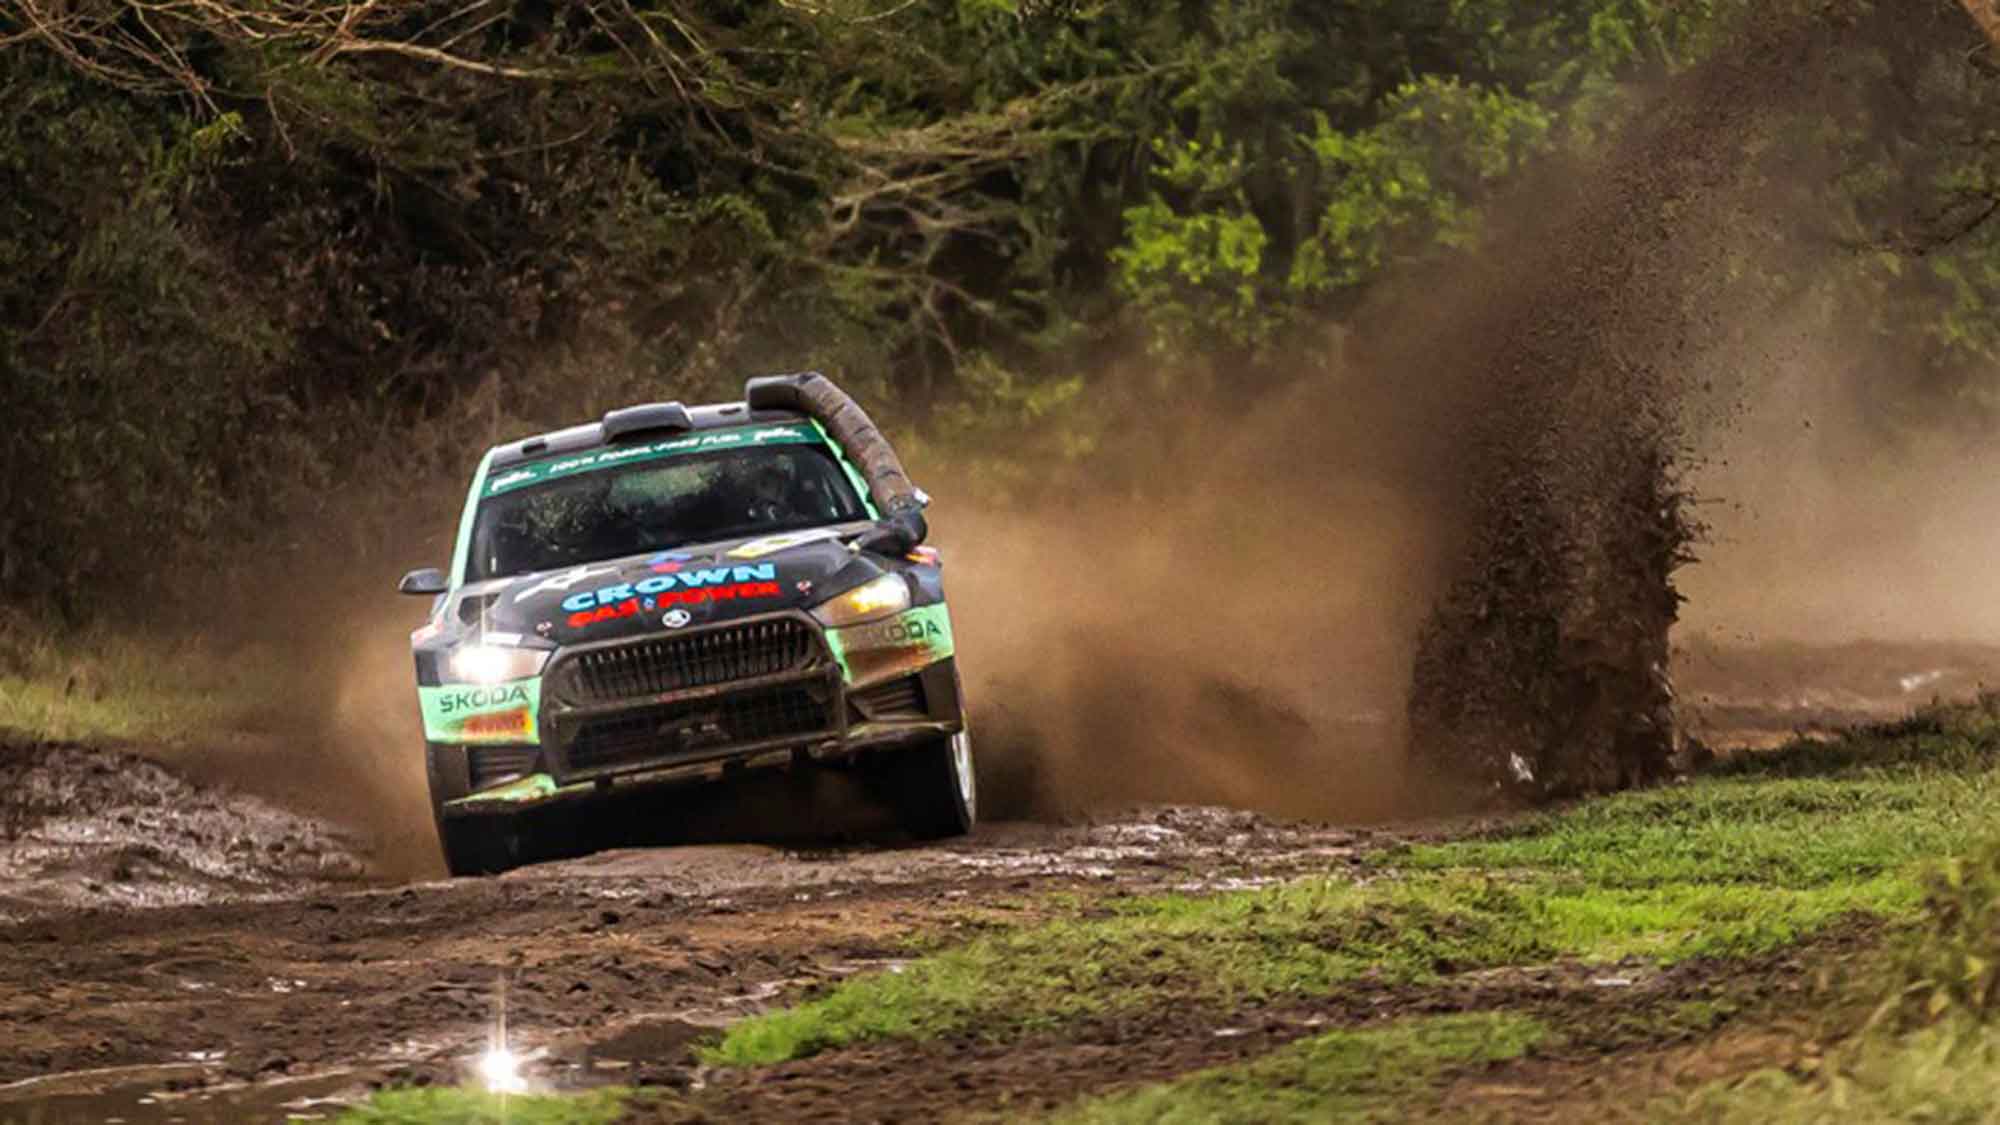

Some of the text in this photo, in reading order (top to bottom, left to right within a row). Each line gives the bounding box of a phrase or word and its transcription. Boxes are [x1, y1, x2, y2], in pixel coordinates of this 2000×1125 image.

[562, 563, 776, 612] CROWN
[566, 582, 782, 628] GAS POWER
